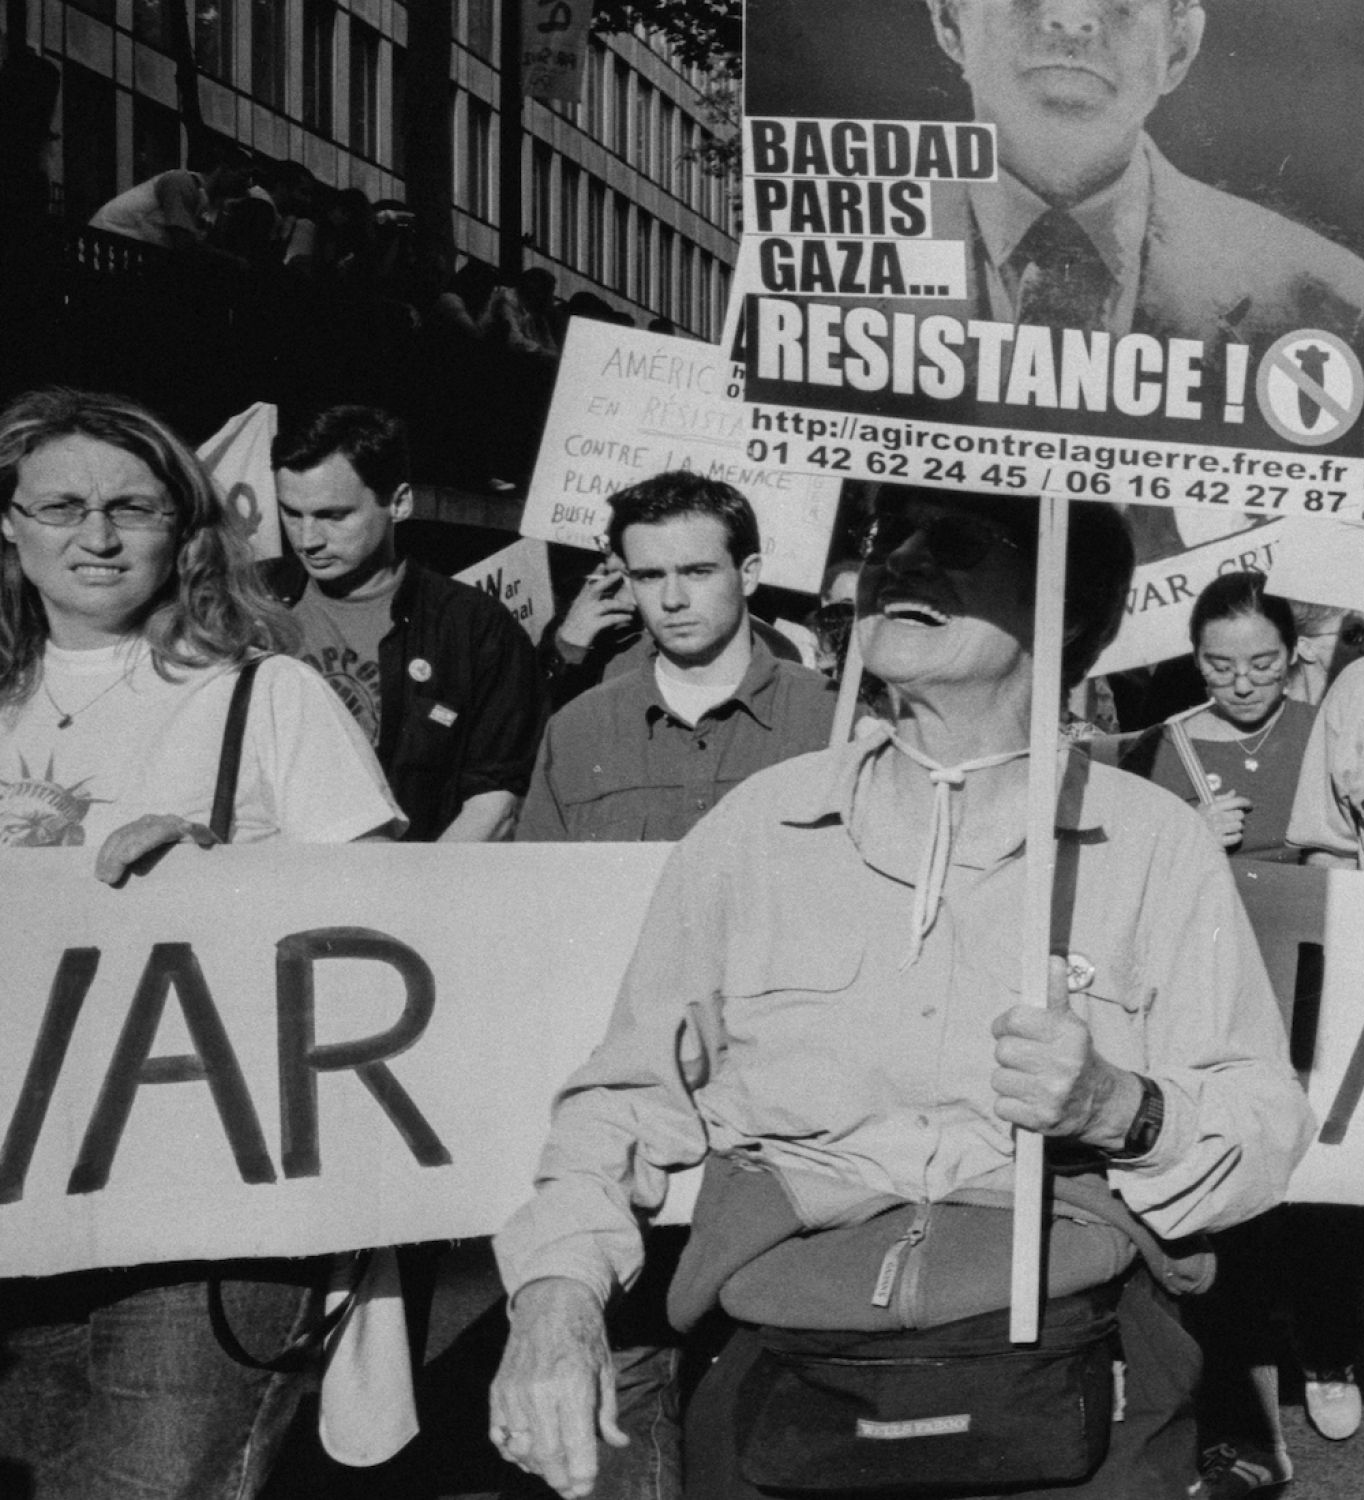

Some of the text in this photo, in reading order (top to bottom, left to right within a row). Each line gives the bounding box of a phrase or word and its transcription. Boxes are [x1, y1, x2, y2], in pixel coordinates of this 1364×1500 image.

[752, 120, 994, 181] BAGDAD
[753, 179, 926, 236] PARIS
[760, 239, 949, 298] GAZA...
[601, 346, 717, 395] AMÉRIC
[758, 299, 1250, 425] RESISTANCE !
[588, 396, 618, 416] EN
[564, 434, 794, 490] CONTRE LA MENACE
[750, 405, 1348, 484] http://agircontrelaguerre.free.fr
[748, 438, 1348, 514] 01 42 62 24 45 / 06 16 42 27 87
[551, 503, 595, 525] BUSH
